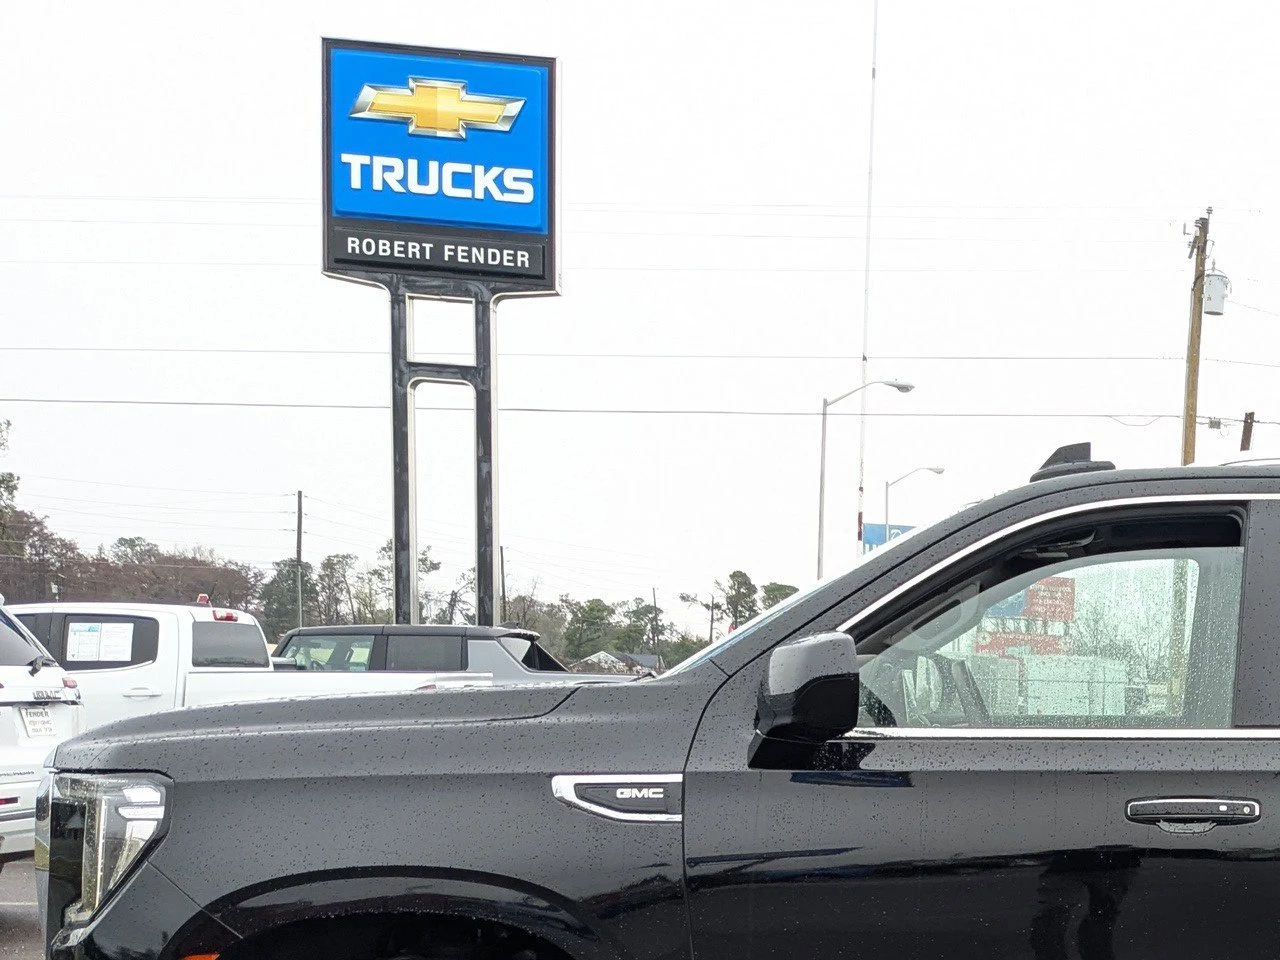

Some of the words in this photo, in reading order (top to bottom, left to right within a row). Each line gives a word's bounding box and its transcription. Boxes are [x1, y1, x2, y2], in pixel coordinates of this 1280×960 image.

[340, 153, 534, 204] TRUCKS
[347, 236, 434, 260] ROBERT
[443, 244, 530, 268] FENDER
[615, 787, 664, 799] GMC
